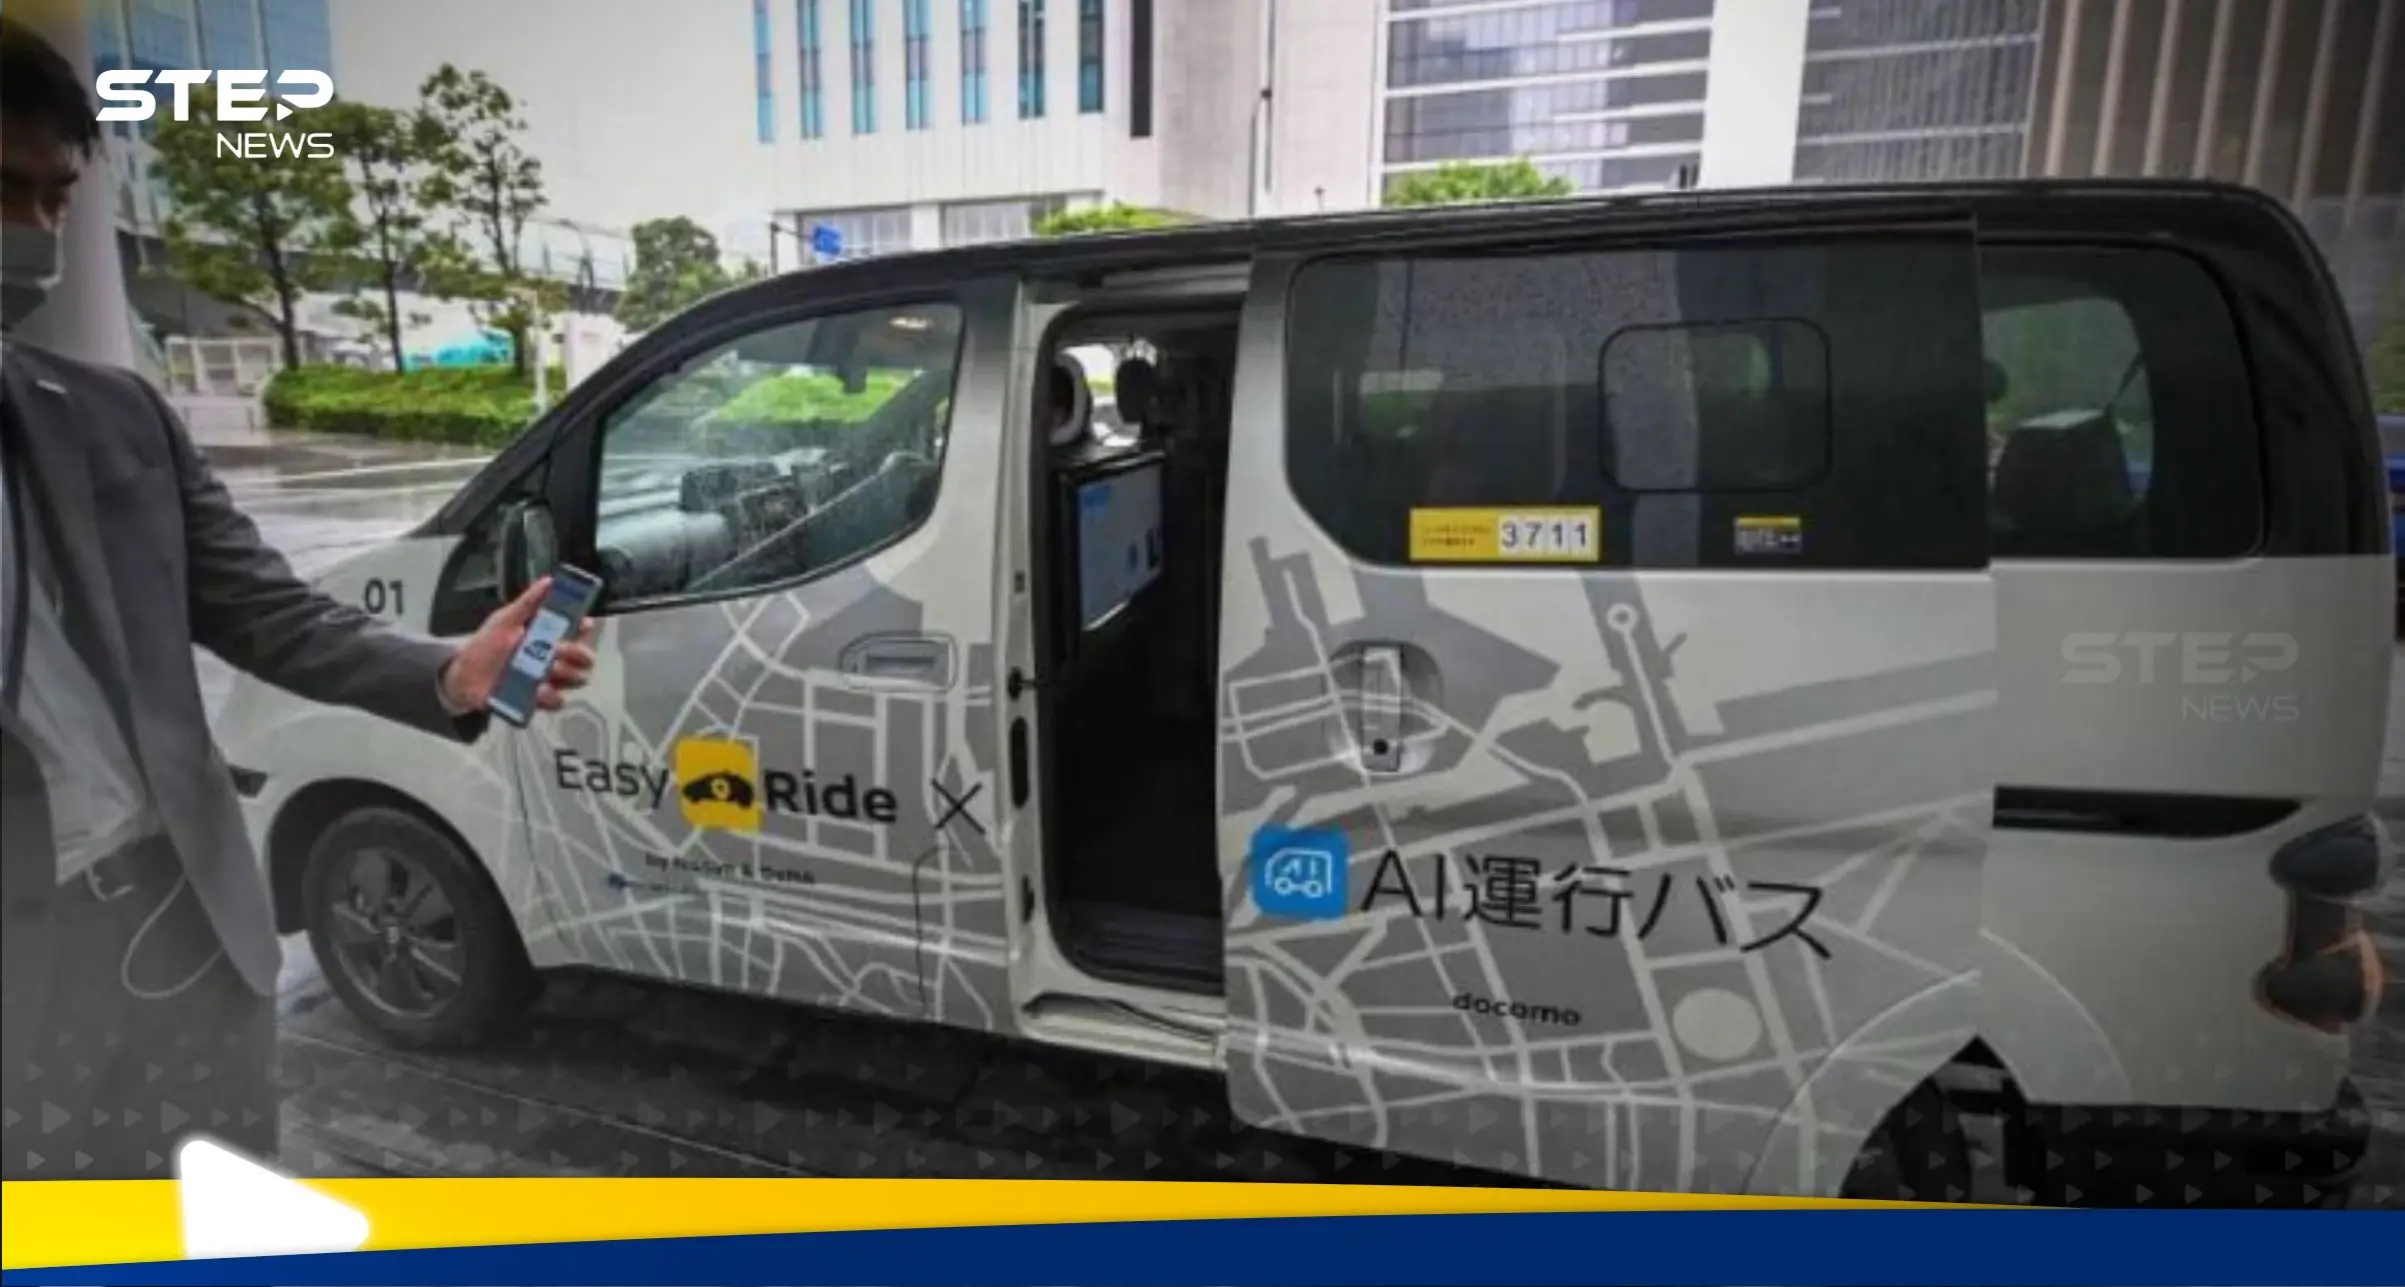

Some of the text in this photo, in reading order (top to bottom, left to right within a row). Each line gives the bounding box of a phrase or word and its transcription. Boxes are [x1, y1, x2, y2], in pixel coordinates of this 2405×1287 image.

[1501, 521, 1588, 548] 3711
[364, 577, 403, 617] 01
[554, 749, 670, 809] Easy
[764, 769, 897, 824] Ride
[1452, 991, 1581, 1027] docomo
